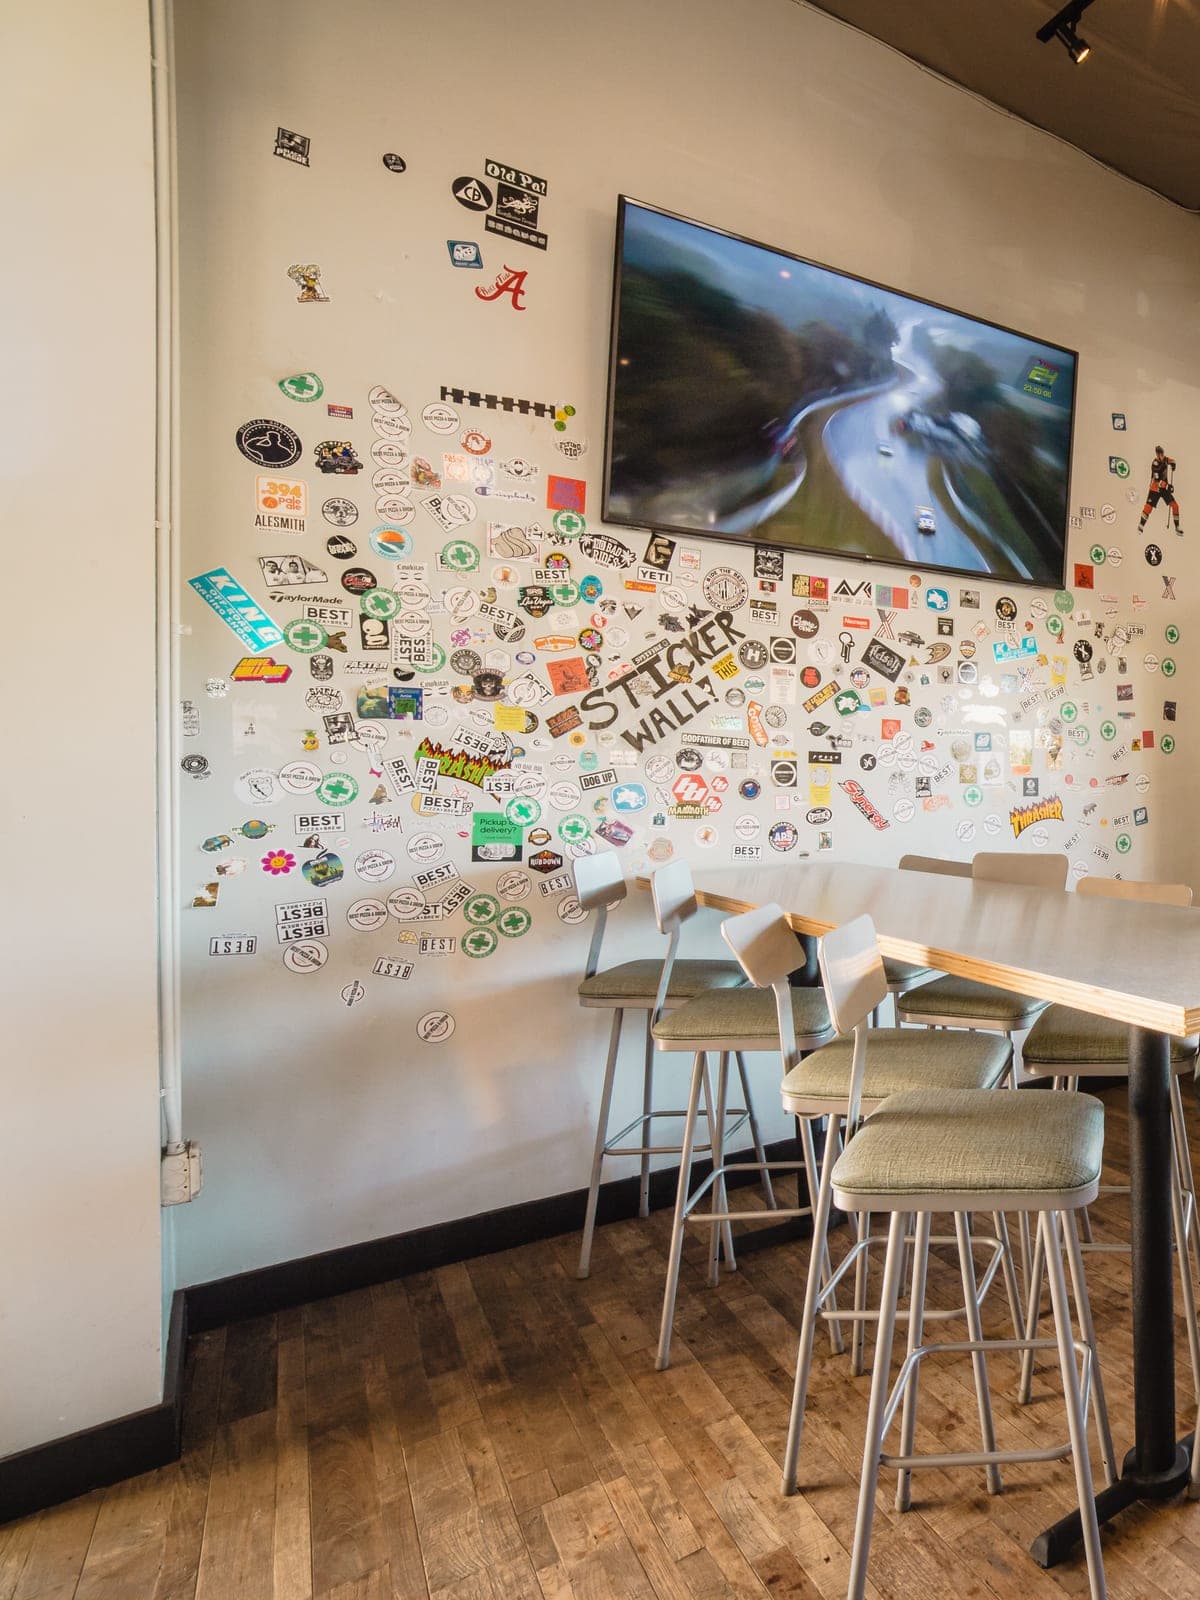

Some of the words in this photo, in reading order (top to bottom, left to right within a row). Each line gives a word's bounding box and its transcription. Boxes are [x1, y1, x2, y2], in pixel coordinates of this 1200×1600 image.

[487, 163, 516, 183] Old
[519, 173, 545, 193] Pal
[559, 441, 582, 451] FLYING
[564, 448, 578, 457] PIG
[278, 496, 302, 505] pale
[286, 503, 302, 511] ale
[255, 514, 305, 532] ALESMITH
[606, 541, 623, 557] BAD
[593, 549, 621, 567] RIDES
[535, 569, 567, 579] BEST
[641, 570, 669, 582] YETI
[706, 571, 717, 583] RIDE
[733, 572, 746, 585] BEST
[193, 582, 226, 616] RACING
[269, 591, 343, 604] TaylorMade
[705, 592, 721, 609] TRUCK
[722, 596, 746, 611] COMPANY
[207, 575, 282, 641] KING
[307, 608, 349, 621] BEST
[480, 603, 514, 622] BEST
[752, 610, 778, 620] BEST
[997, 621, 1016, 630] BEST
[580, 611, 746, 731] STICKER
[715, 661, 738, 681] THIS
[308, 686, 341, 699] SWELL
[1048, 687, 1065, 700] BEST
[1022, 693, 1040, 709] BEST
[620, 675, 719, 753] WALL!
[455, 733, 490, 753] BEST
[682, 734, 720, 744] GODFATHER
[722, 736, 732, 745] OF
[732, 738, 750, 747] BEER
[1112, 746, 1128, 761] BEST
[391, 759, 416, 790] BEST
[420, 760, 437, 792] BEST
[583, 775, 601, 788] DOG
[602, 772, 613, 782] UP
[933, 764, 952, 783] BEST
[424, 796, 460, 809] BEST
[668, 805, 709, 816] MAMMOTH
[1009, 795, 1064, 839] THRASHER
[300, 815, 341, 827] BEST
[480, 818, 507, 826] Pickup
[1113, 816, 1129, 826] BEST
[480, 826, 517, 835] delivery?
[1064, 833, 1080, 850] BEST
[734, 846, 761, 855] BEST
[1094, 847, 1110, 860] BEST
[417, 864, 453, 885] BEST
[541, 876, 571, 894] BEST
[443, 886, 471, 915] BEST
[281, 906, 324, 921] BEST
[283, 924, 325, 941] BEST
[212, 940, 254, 953] BEST
[422, 938, 454, 951] BEST
[376, 960, 411, 978] BEST
